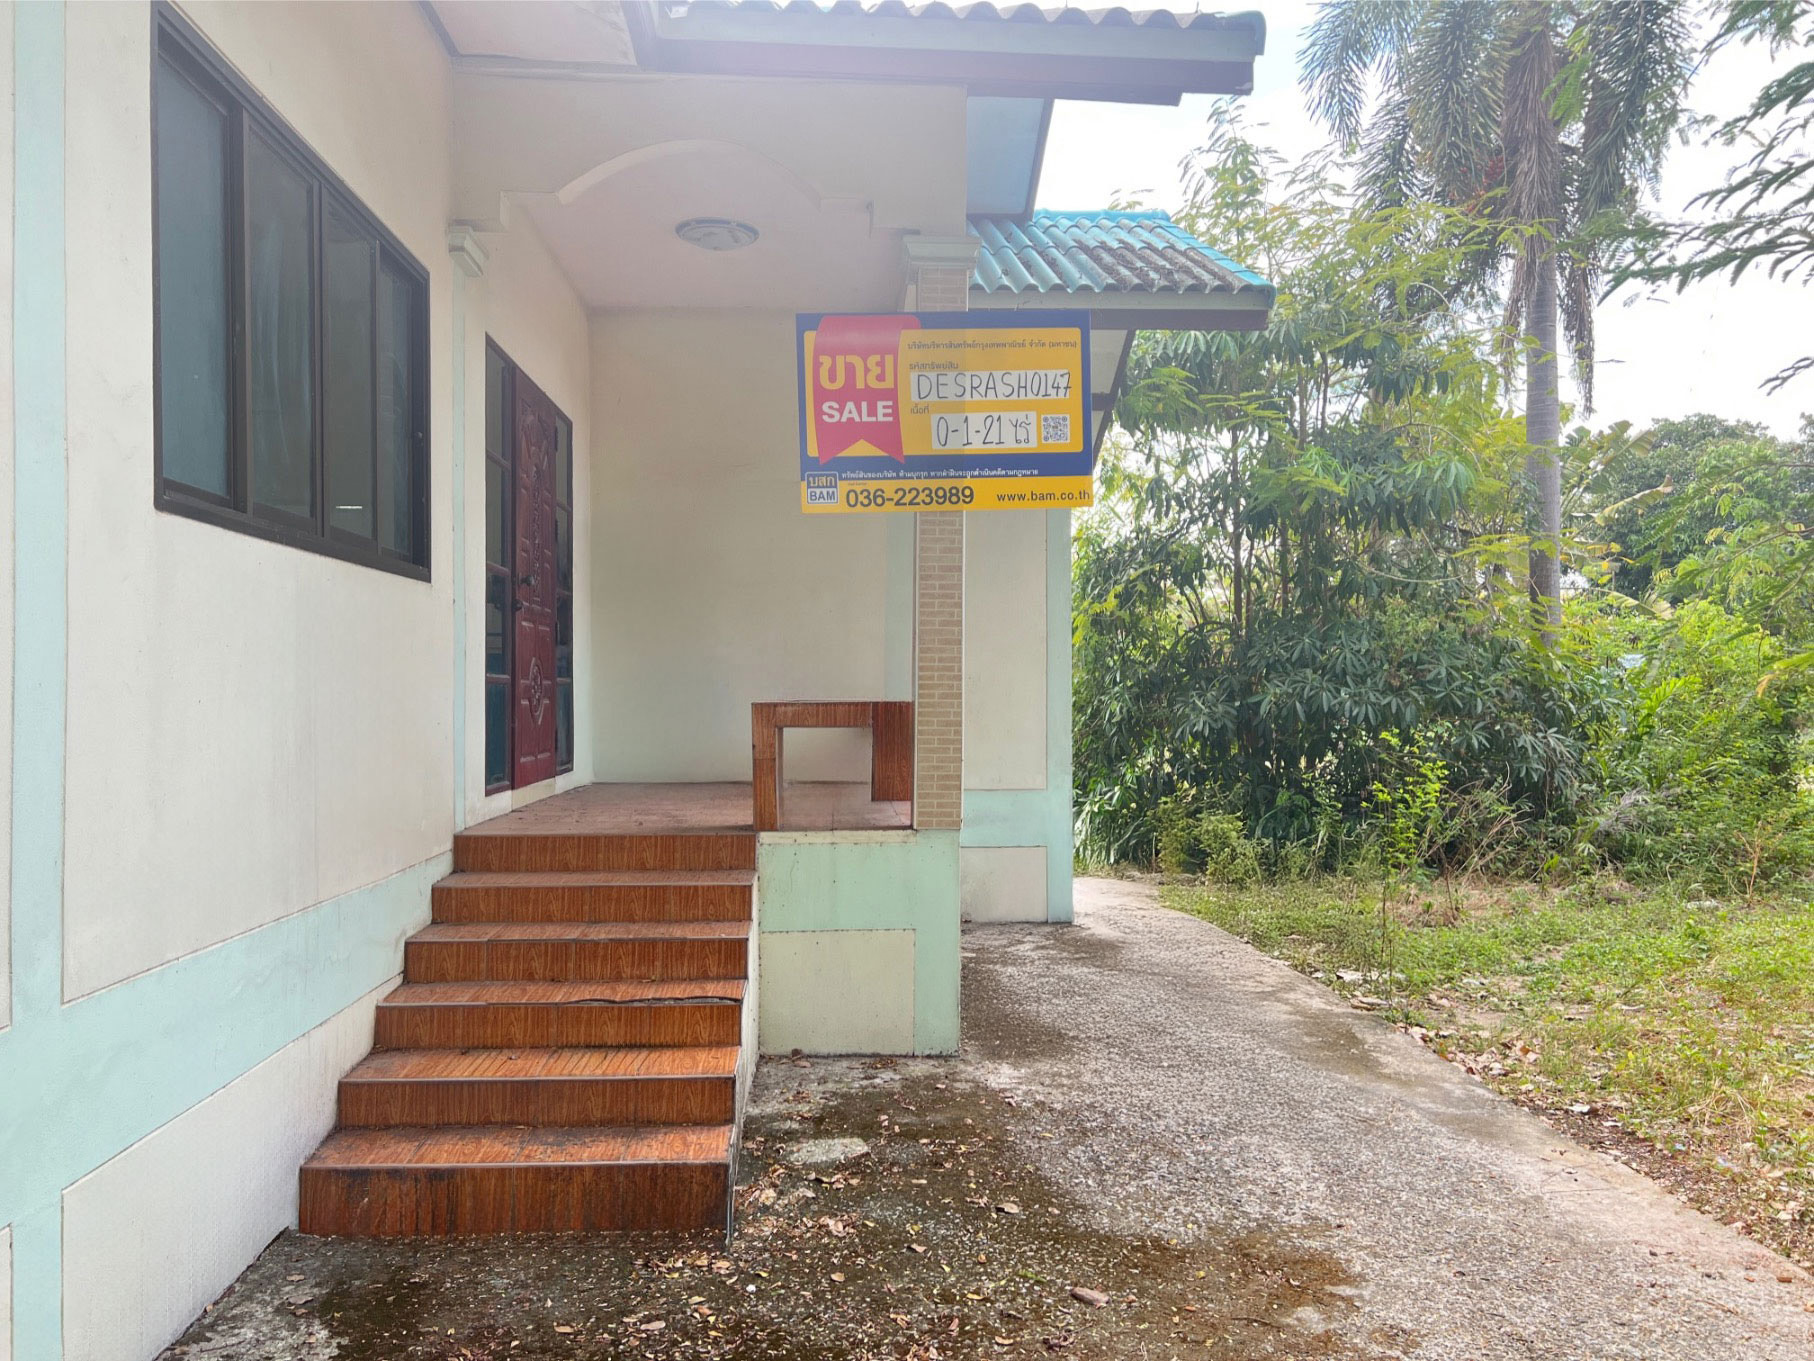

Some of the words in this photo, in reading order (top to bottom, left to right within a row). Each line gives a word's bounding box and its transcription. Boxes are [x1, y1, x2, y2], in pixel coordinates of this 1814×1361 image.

[1029, 340, 1046, 348] จำกัด
[1049, 340, 1077, 349] (มหาชน)
[819, 354, 894, 390] ขาย
[822, 401, 893, 423] SALE
[910, 403, 930, 415] เนื้อที่
[936, 414, 1005, 447] 0-1-21
[808, 475, 835, 487] บสก
[809, 490, 836, 502] BAM
[846, 486, 975, 508] 036-223989
[996, 489, 1091, 502] www.bam.co.th
